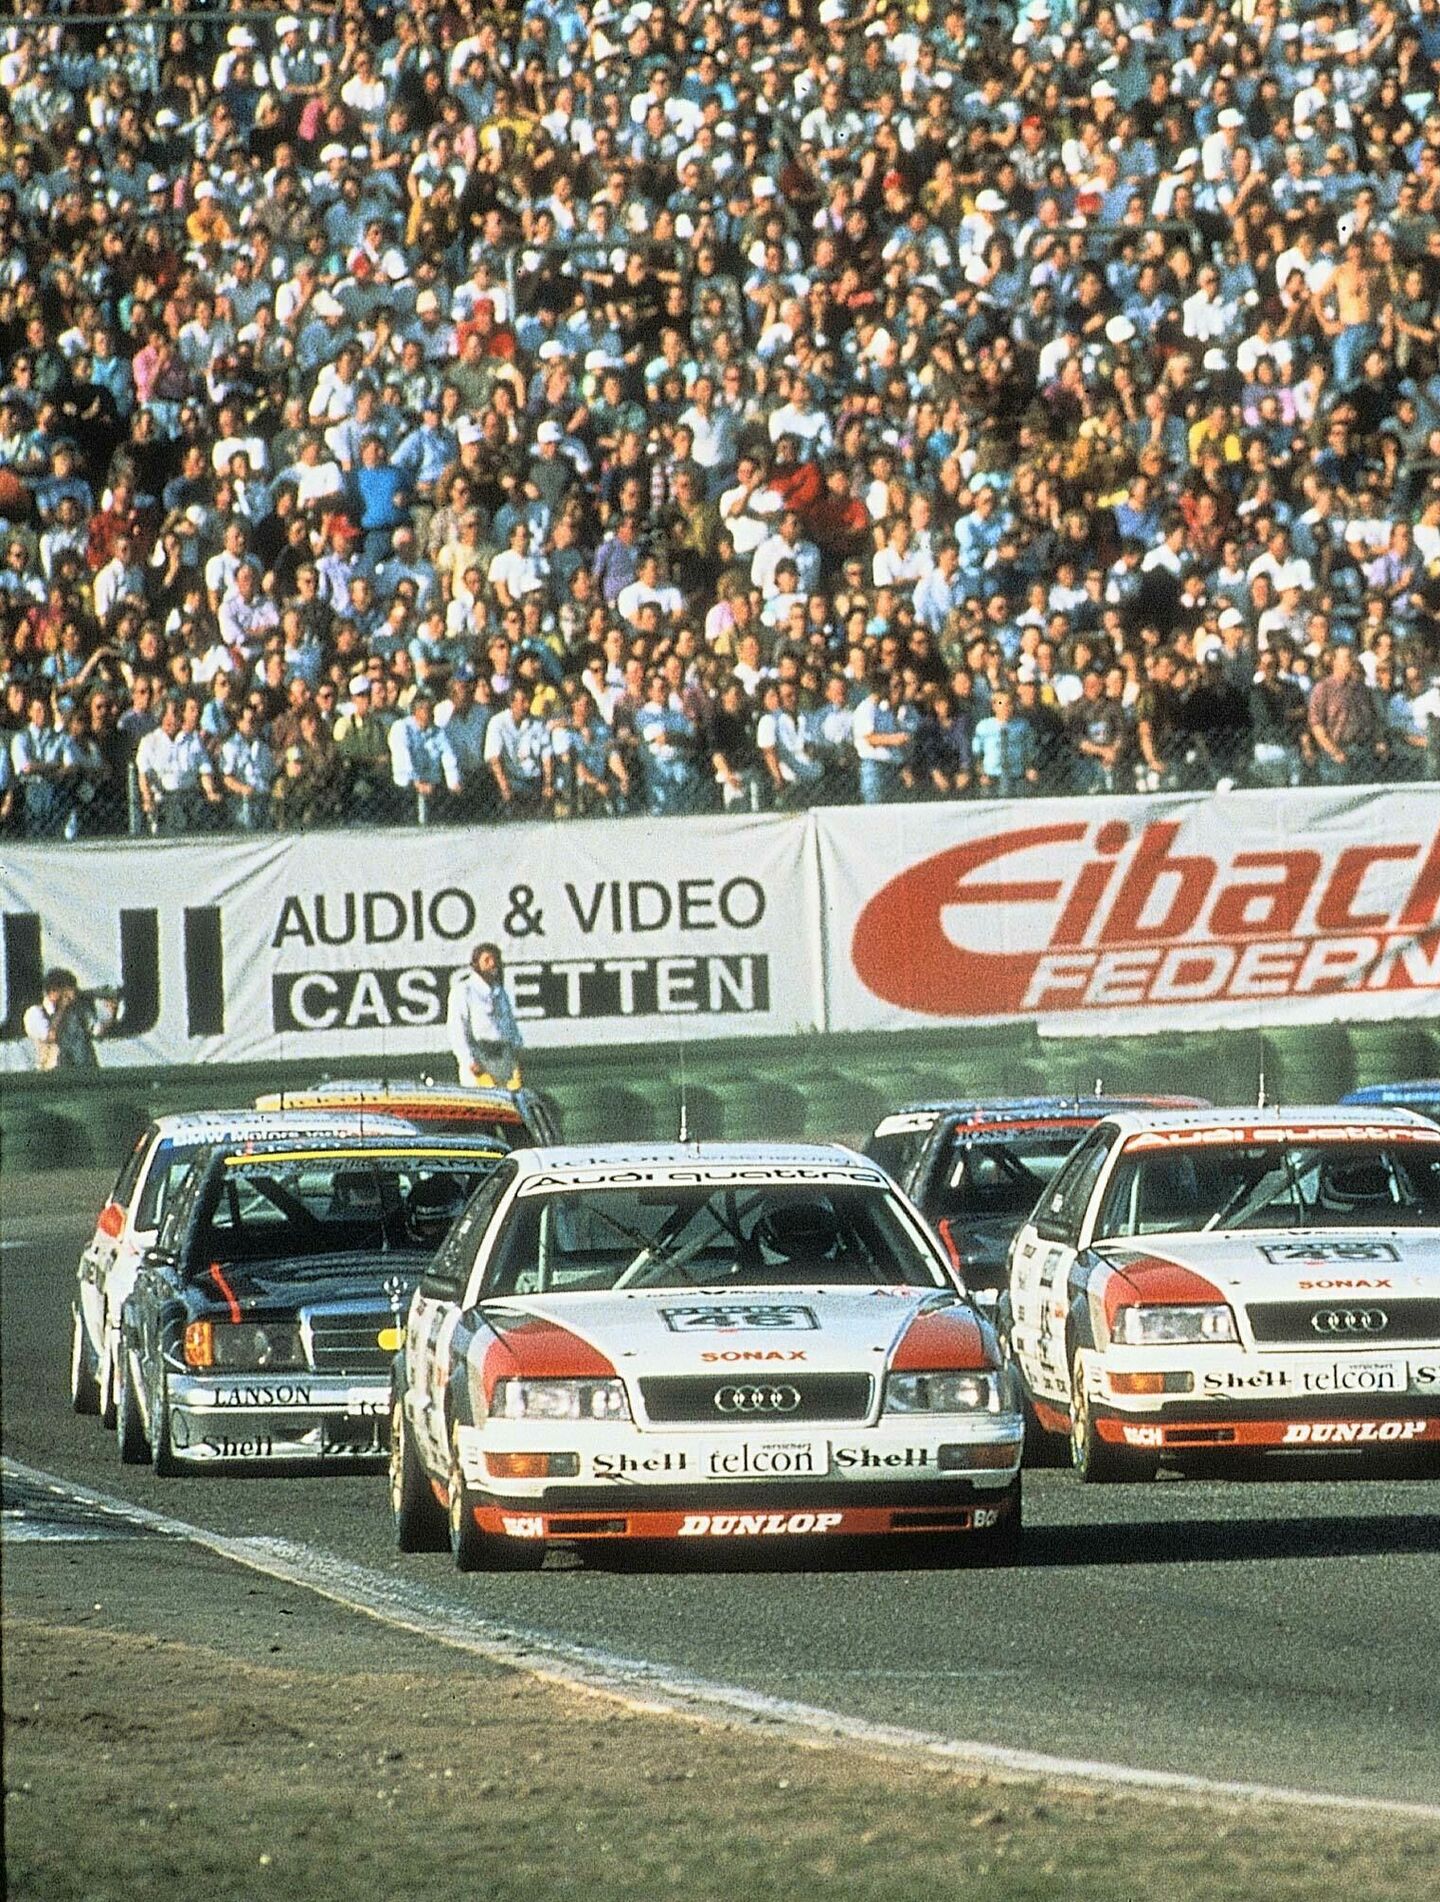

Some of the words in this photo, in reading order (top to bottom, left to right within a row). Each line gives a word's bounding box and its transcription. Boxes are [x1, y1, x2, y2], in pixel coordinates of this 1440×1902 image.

[271, 887, 477, 948] AUDIO
[503, 883, 546, 937] &
[565, 876, 767, 933] VIDEO
[289, 954, 756, 1029] CASETTEN
[1124, 1128, 1244, 1152] Audi
[526, 1171, 653, 1191] Audi
[668, 1168, 882, 1184] quattro
[1299, 1279, 1393, 1290] SONAX
[701, 1350, 807, 1363] SONAX
[1203, 1370, 1287, 1388] Shell
[1304, 1363, 1395, 1391] telcon
[213, 1385, 312, 1406] LANSON
[1282, 1421, 1427, 1443] DUNLOP
[202, 1434, 272, 1457] Shell
[835, 1446, 928, 1468] Shell
[592, 1453, 688, 1473] Shell
[709, 1442, 814, 1474] telcon
[678, 1512, 843, 1537] DUNLOP
